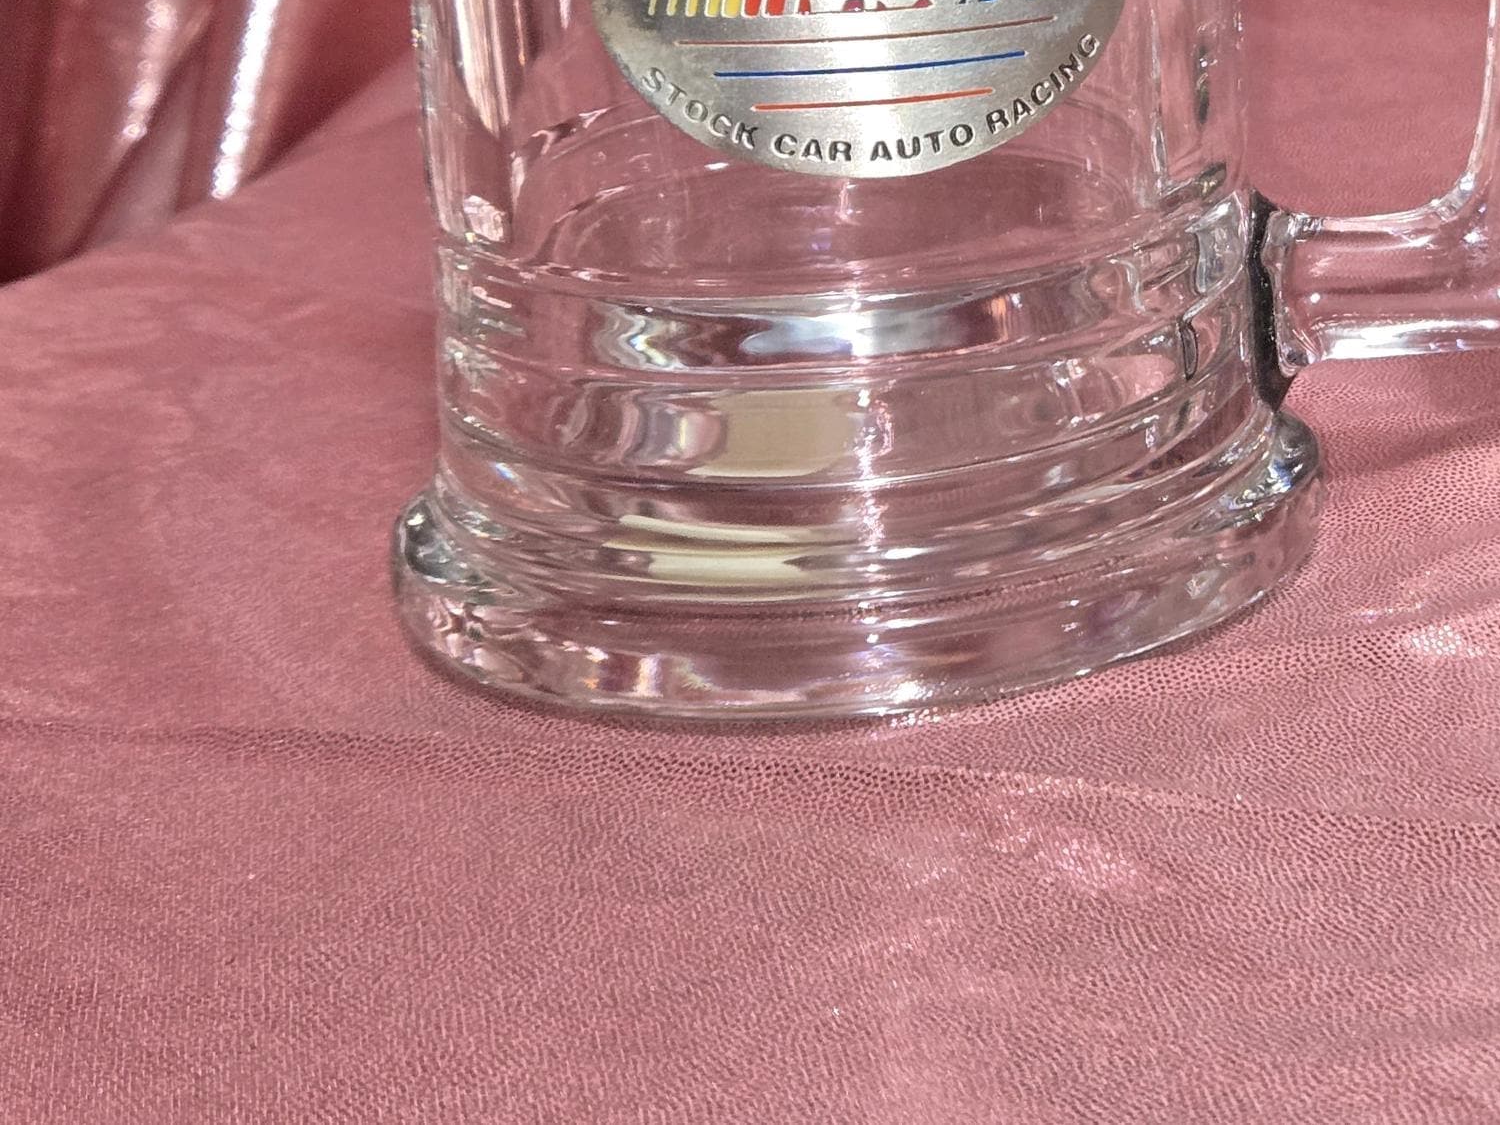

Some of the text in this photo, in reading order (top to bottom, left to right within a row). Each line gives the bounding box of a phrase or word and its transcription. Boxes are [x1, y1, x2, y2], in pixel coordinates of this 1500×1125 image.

[642, 33, 1102, 162] STOCK CAR AUTO RACING
